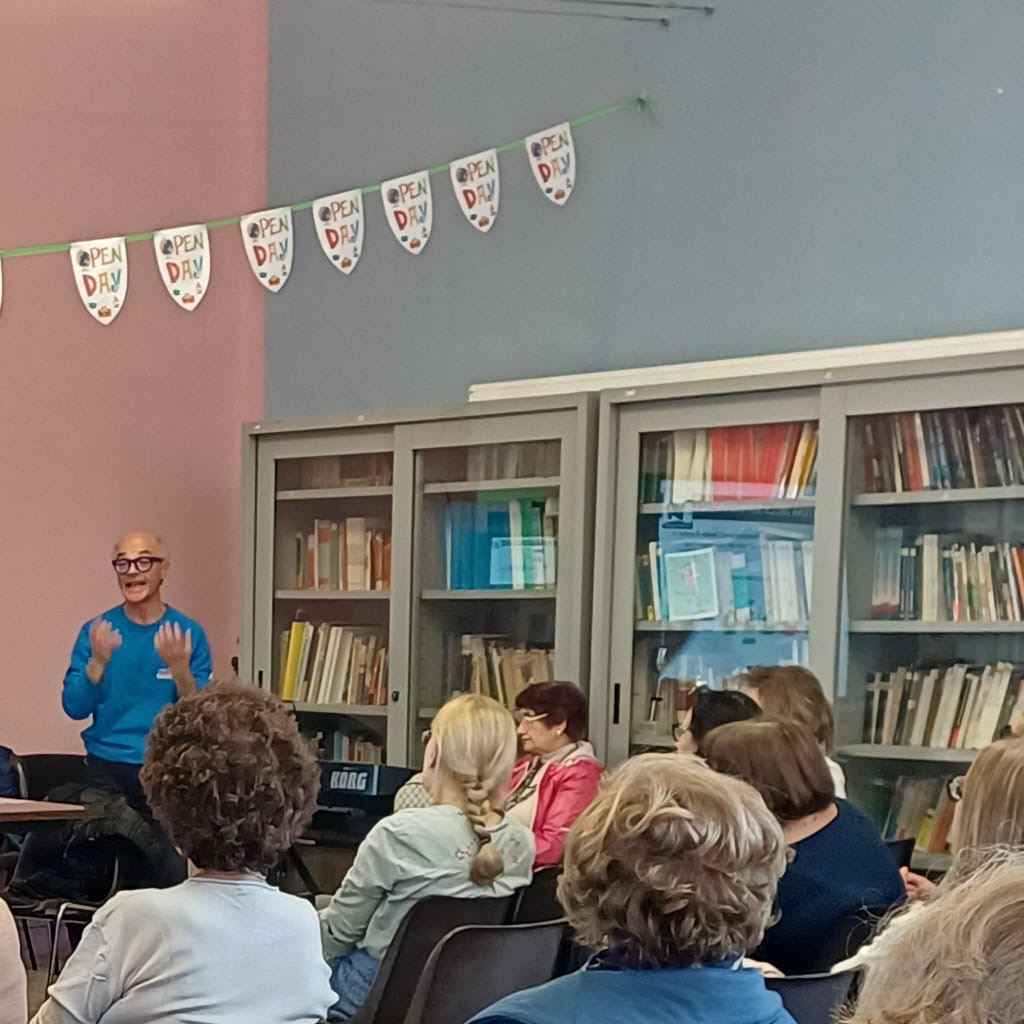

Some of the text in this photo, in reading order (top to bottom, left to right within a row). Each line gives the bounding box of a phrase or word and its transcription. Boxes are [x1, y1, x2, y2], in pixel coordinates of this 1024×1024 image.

[538, 152, 571, 183] DAY
[462, 179, 496, 210] DAY
[393, 203, 427, 231] DAY
[325, 220, 360, 249] DAY
[252, 240, 288, 266] DAY
[82, 269, 122, 297] DAY
[166, 255, 204, 283] DAY
[330, 771, 368, 790] KORG
